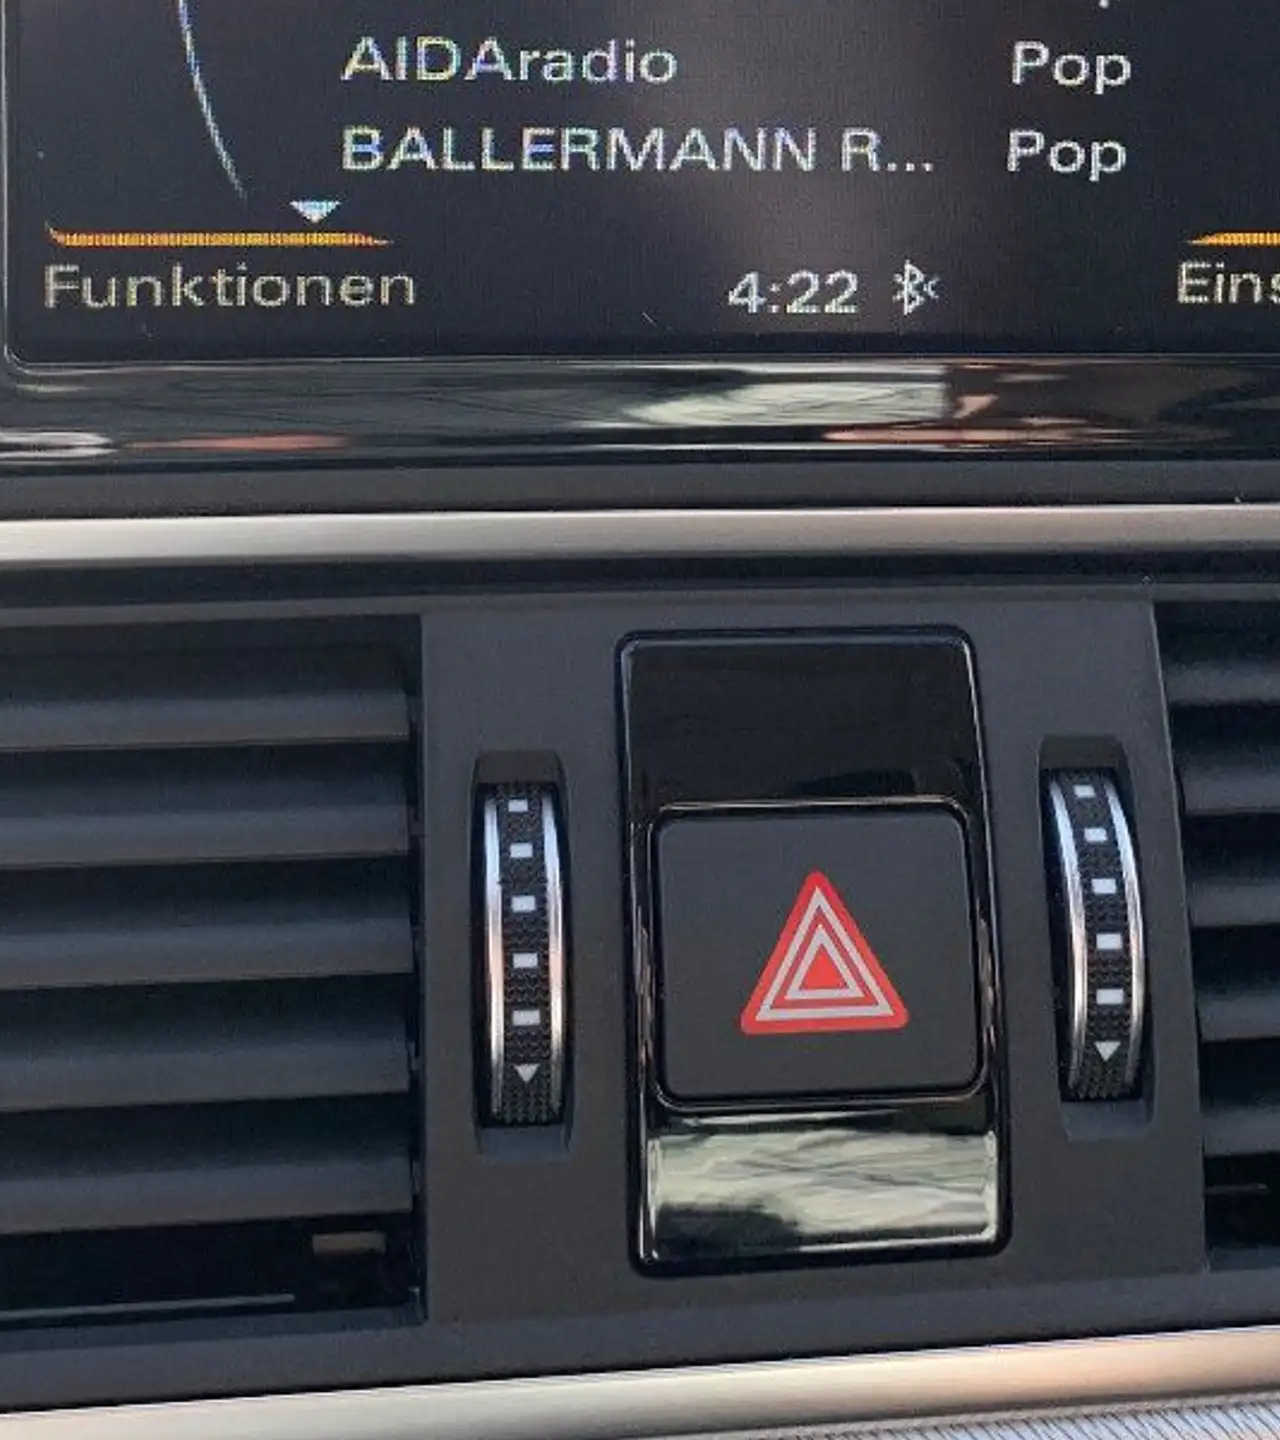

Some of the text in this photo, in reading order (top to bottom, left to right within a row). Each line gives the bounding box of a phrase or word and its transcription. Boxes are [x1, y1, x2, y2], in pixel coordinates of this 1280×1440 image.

[340, 36, 679, 83] AIDAradio
[1011, 40, 1132, 95] Pop
[342, 126, 935, 173] BALLERMANN R...
[1007, 130, 1128, 182] Pop
[43, 263, 418, 310] Funktionen
[727, 269, 859, 315] 4:22
